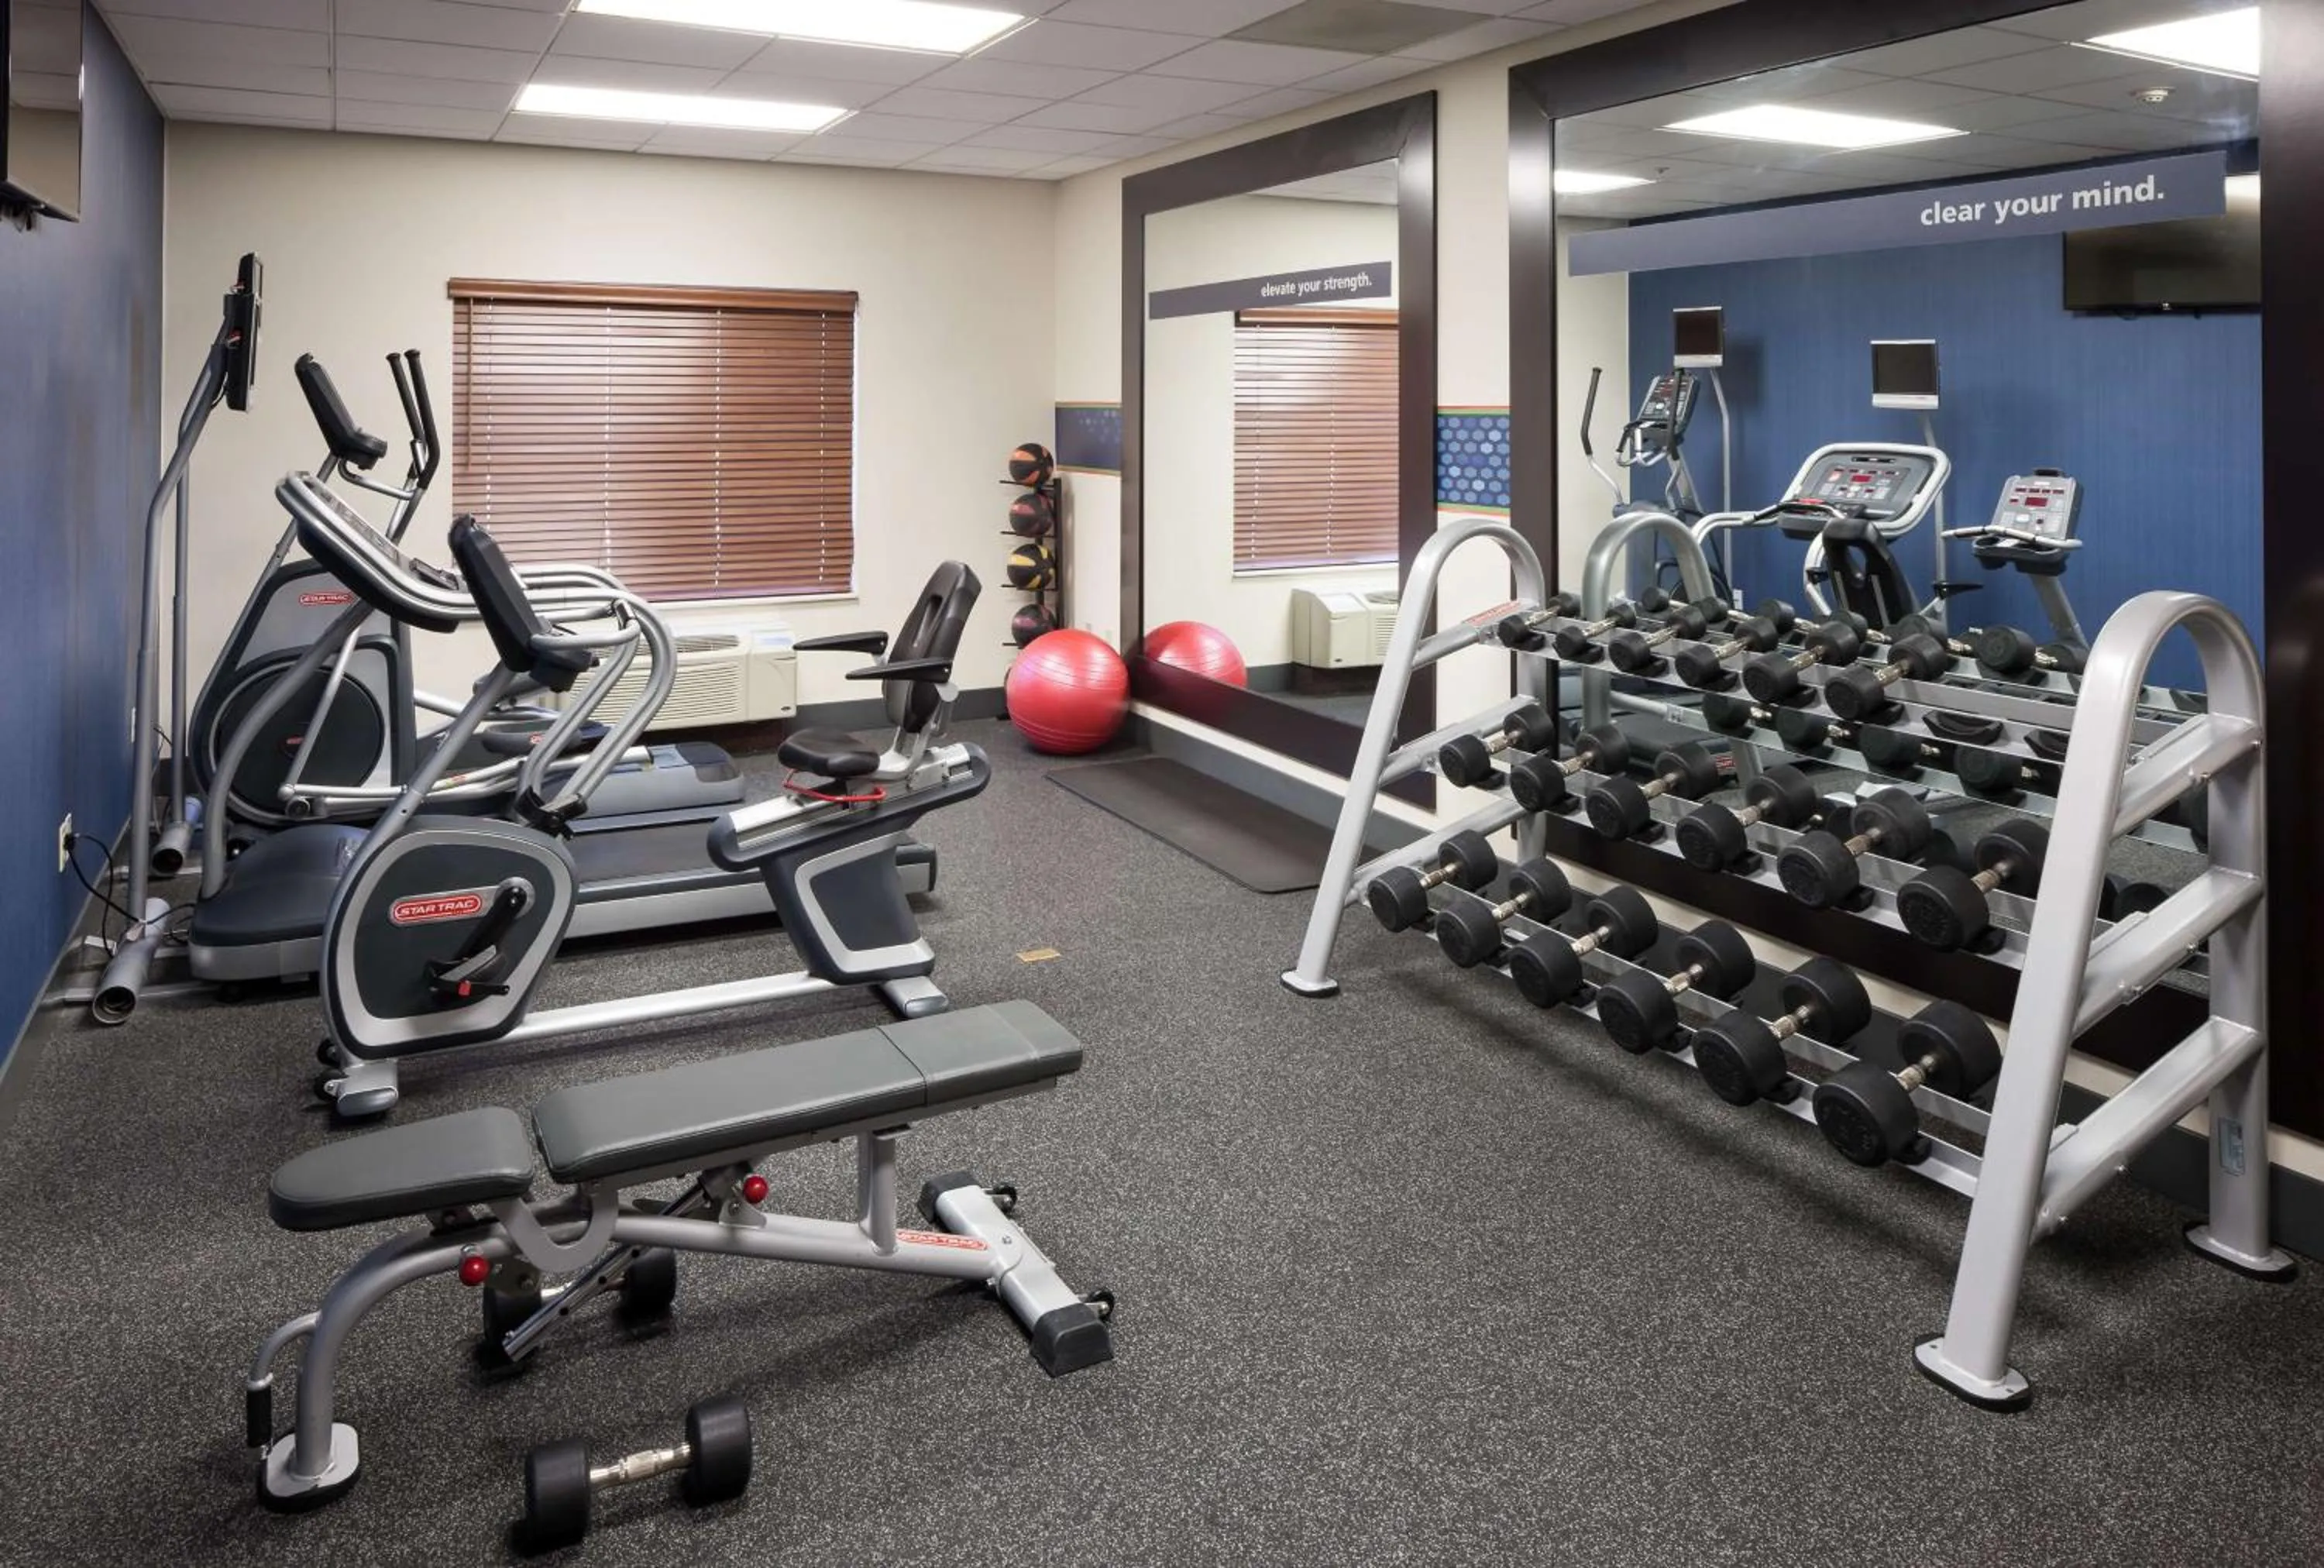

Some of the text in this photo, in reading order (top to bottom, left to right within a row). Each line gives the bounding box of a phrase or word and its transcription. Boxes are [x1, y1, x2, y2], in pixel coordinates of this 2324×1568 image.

[1920, 174, 2164, 225] clear your mind.
[1261, 272, 1372, 297] elevate your strength.
[401, 899, 474, 916] STAR TRAC
